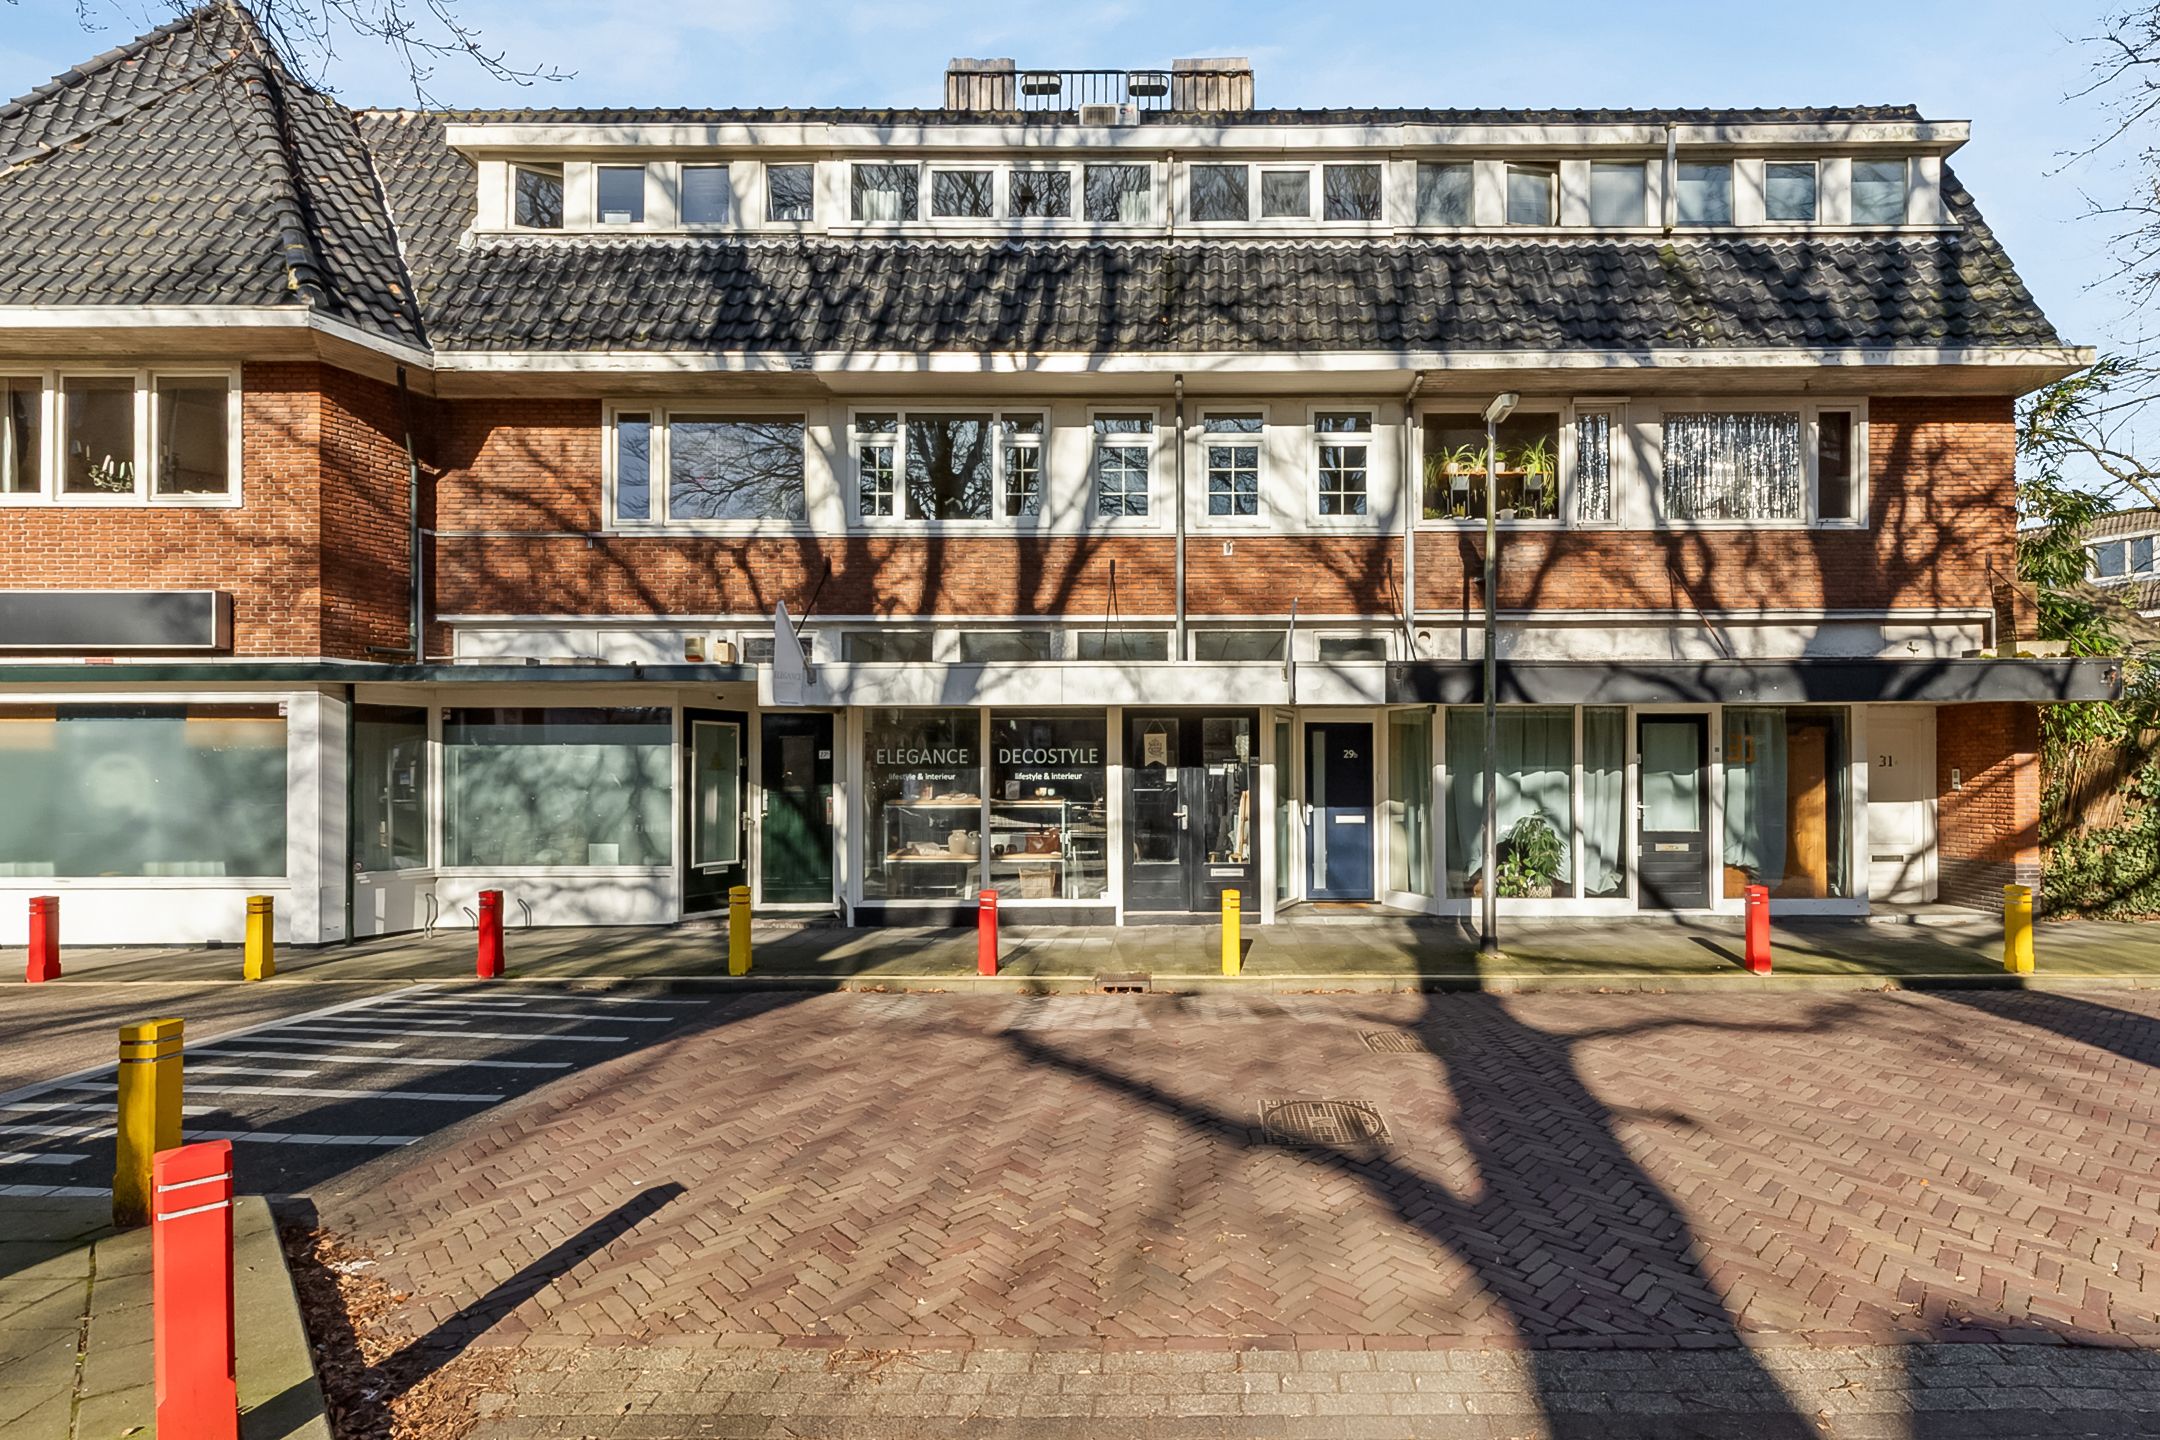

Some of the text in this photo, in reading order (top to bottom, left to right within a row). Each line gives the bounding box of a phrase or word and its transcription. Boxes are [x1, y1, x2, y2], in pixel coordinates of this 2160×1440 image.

[876, 748, 969, 765] ELEGANCE
[999, 748, 1099, 764] DECOSTYLE
[1878, 754, 1893, 768] 31
[888, 772, 917, 782] lifestyle
[925, 773, 956, 781] interieur
[1014, 772, 1082, 782] lifestyle & interieur
